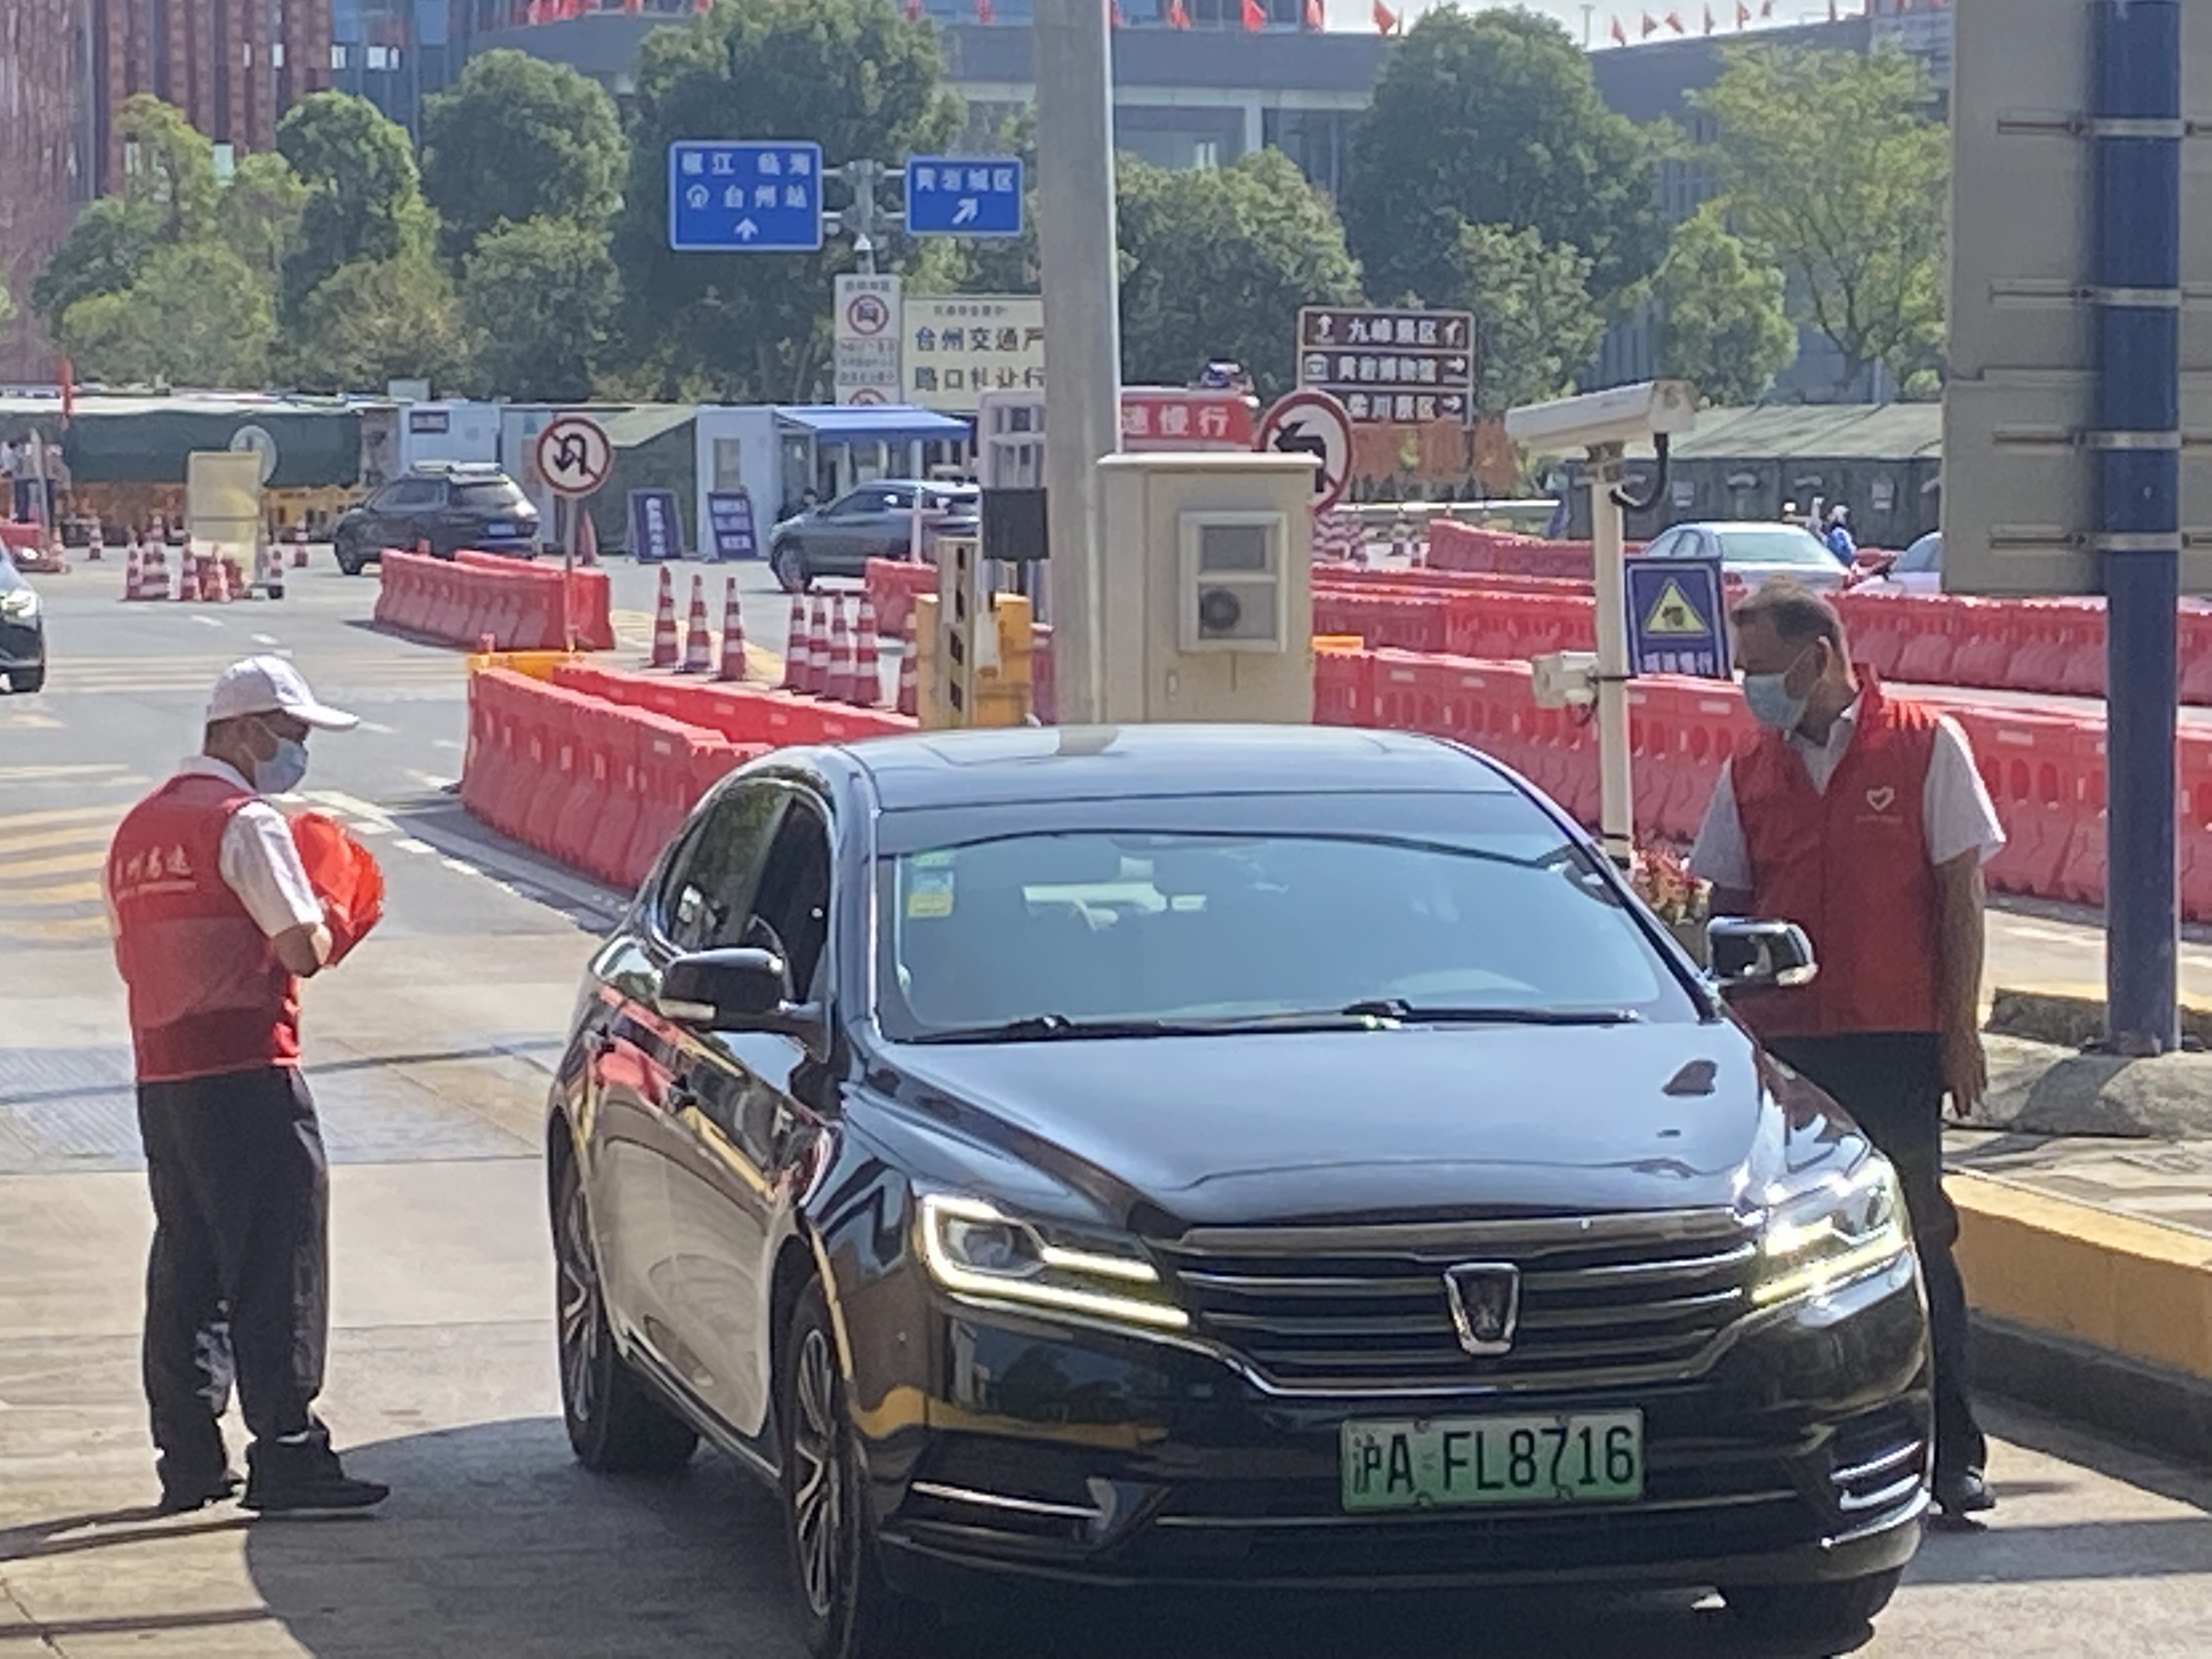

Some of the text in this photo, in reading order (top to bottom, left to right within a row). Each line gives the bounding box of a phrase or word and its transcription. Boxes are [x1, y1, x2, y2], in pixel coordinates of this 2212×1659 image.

[916, 168, 1013, 191] 黄岩城区
[724, 184, 808, 208] 台州站
[1348, 318, 1437, 343] 九峰景区
[1339, 356, 1436, 382] 黄岩博物馆
[1443, 1425, 1634, 1491] FL8716
